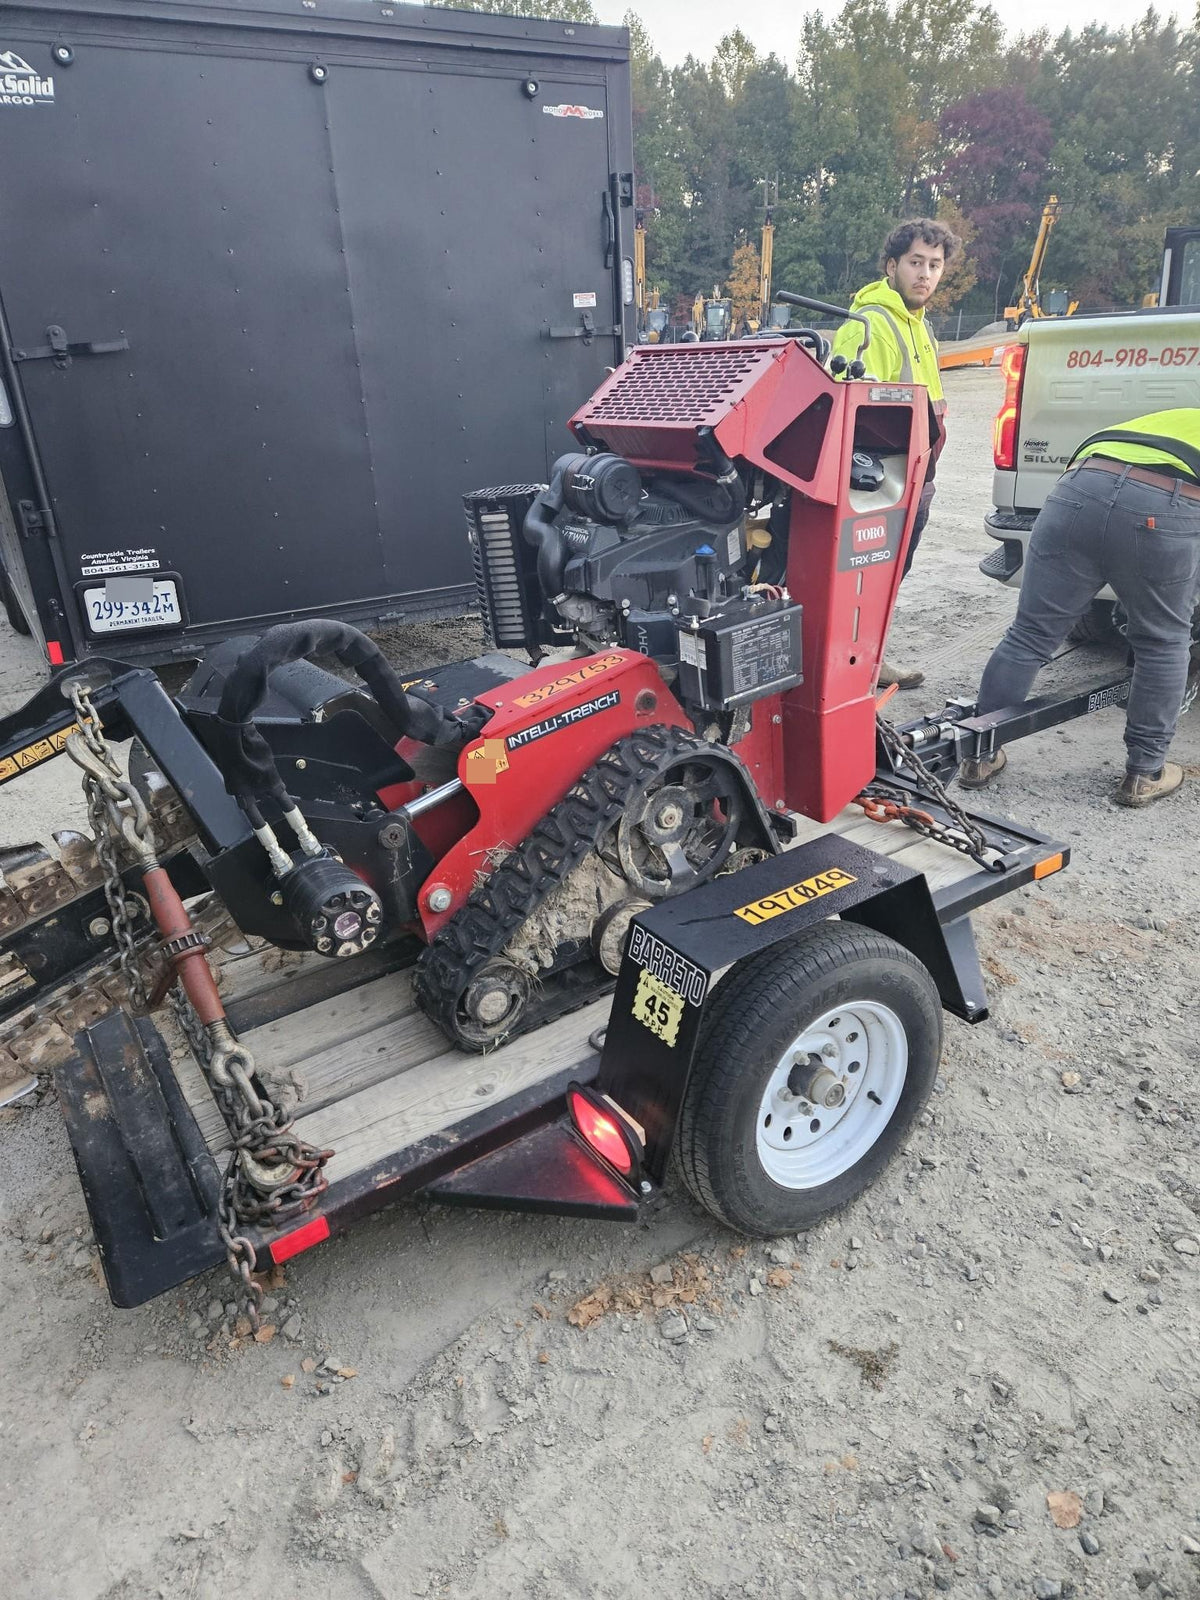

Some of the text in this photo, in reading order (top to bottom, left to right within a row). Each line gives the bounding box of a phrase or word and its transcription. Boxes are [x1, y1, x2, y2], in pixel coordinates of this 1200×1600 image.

[1067, 347, 1200, 369] 804-918-057
[855, 525, 885, 542] TORO
[81, 550, 124, 560] Countryside
[83, 562, 159, 575] 804-561-3518
[109, 615, 164, 628] PERMANENT TRAILER
[522, 655, 623, 703] 329753
[1088, 681, 1130, 713] BARRETO
[508, 692, 618, 749] INTELLI-TRENCH
[743, 871, 855, 920] 197049
[628, 924, 707, 1008] BARRETO
[645, 994, 670, 1026] 45
